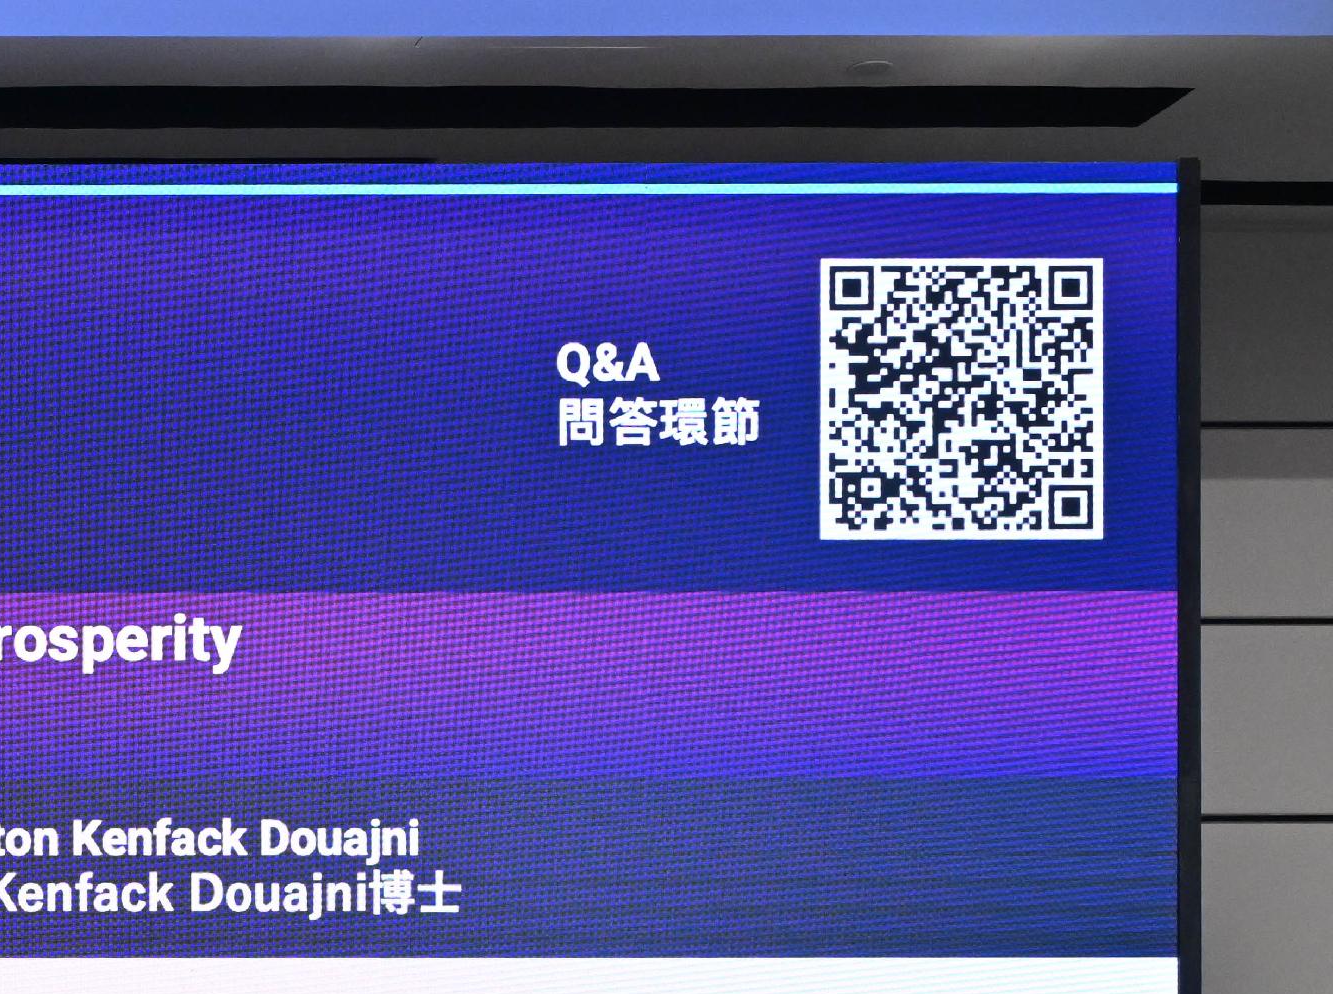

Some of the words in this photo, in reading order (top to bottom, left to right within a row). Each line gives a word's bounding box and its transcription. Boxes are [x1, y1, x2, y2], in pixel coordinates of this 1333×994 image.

[556, 342, 660, 385] Q&A
[559, 396, 760, 446] 問答環節
[72, 817, 248, 857] Kenfack
[260, 818, 419, 867] Douajni
